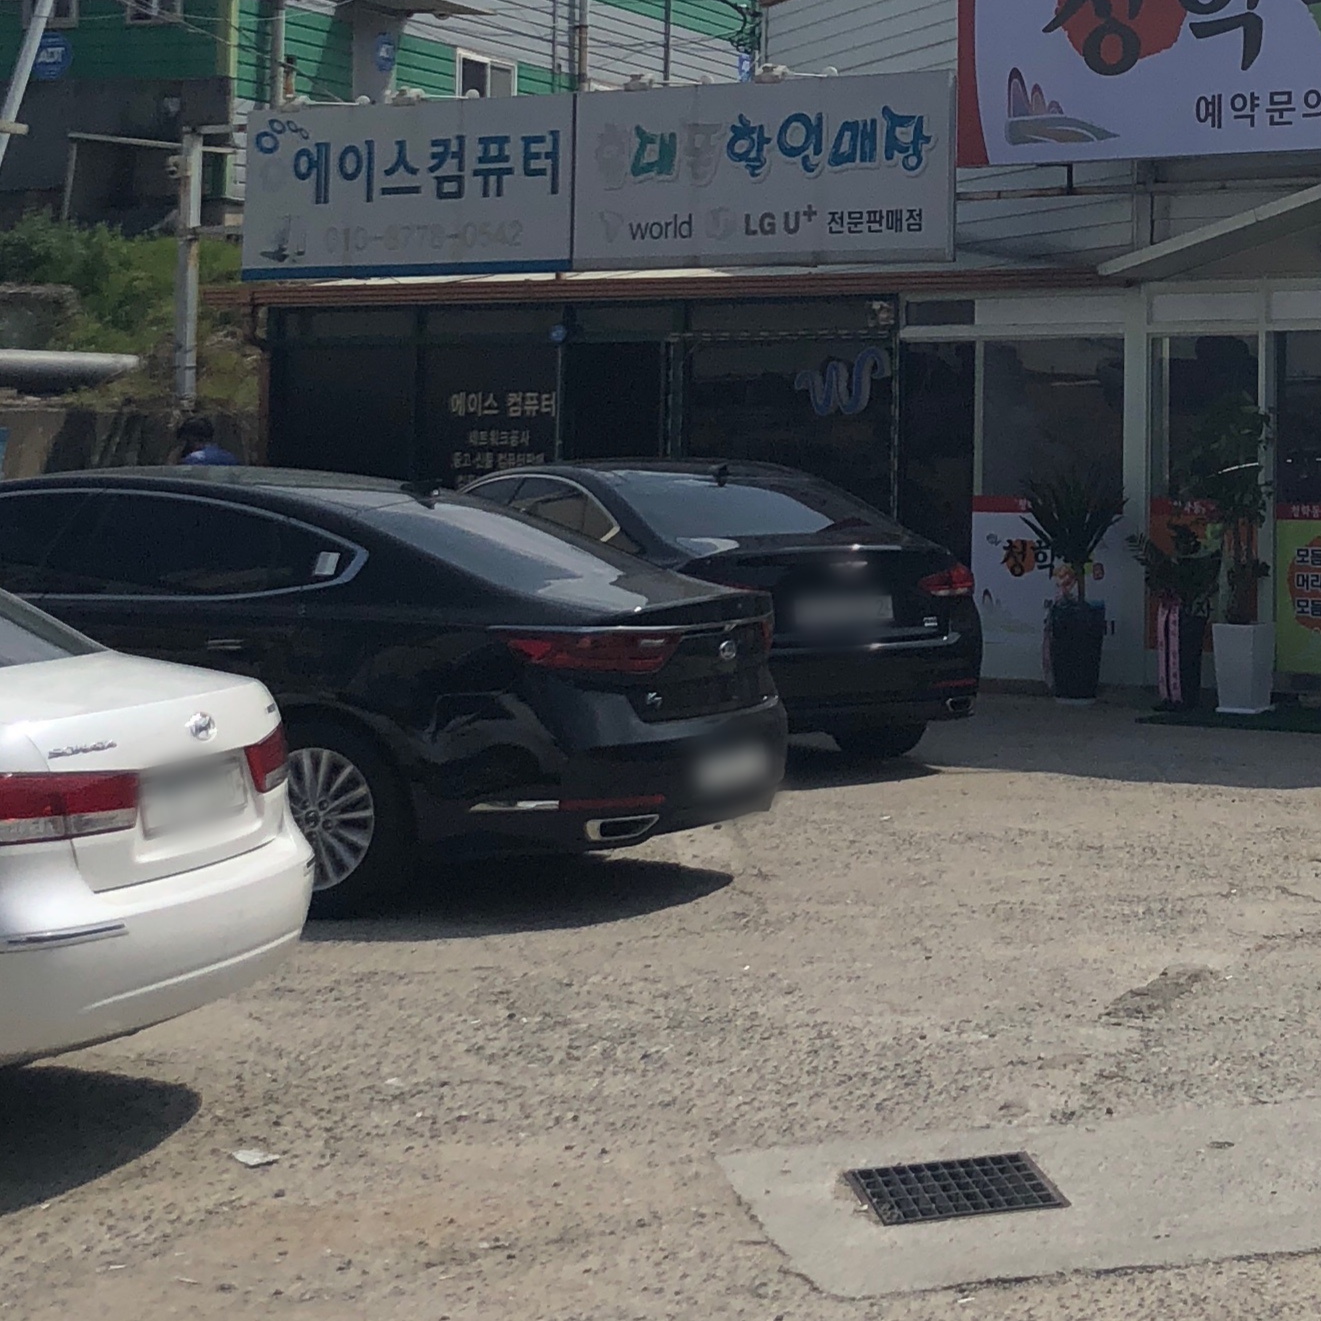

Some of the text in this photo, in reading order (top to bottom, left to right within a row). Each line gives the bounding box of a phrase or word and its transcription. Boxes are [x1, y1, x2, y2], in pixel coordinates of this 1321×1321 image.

[293, 130, 561, 205] 에이스컴퓨터
[629, 212, 693, 241] world
[744, 212, 776, 236] LG
[826, 207, 923, 235] 전문판매점
[450, 390, 557, 417] 에이스 컴퓨터
